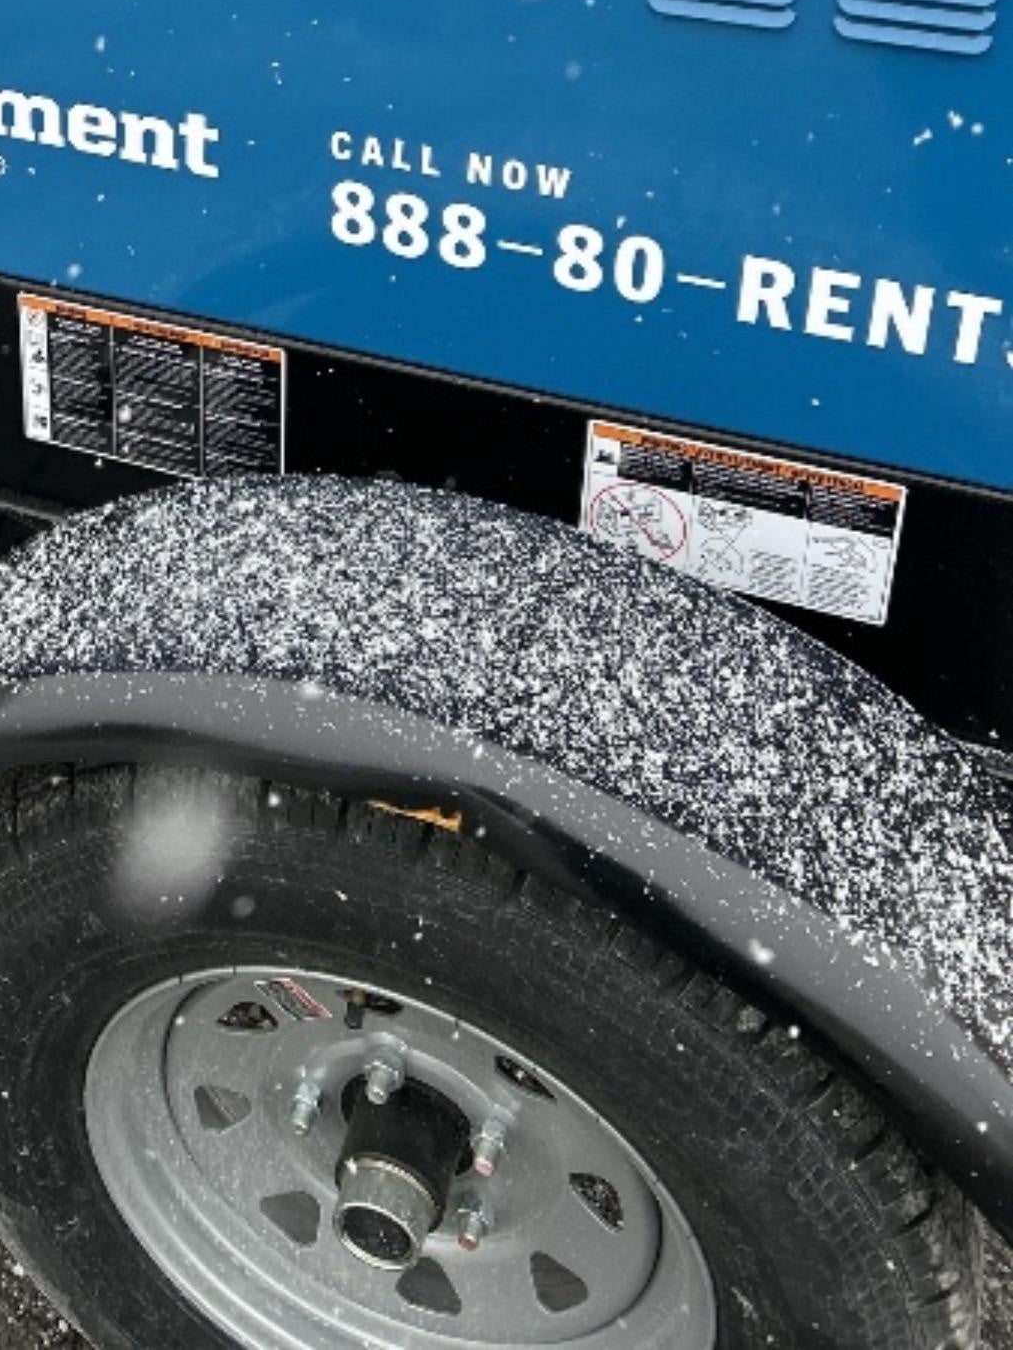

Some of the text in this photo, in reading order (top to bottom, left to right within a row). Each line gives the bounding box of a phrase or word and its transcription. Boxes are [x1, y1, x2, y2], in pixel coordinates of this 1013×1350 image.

[330, 130, 574, 200] CALL NOW
[329, 180, 1013, 370] 888-80-RENT
